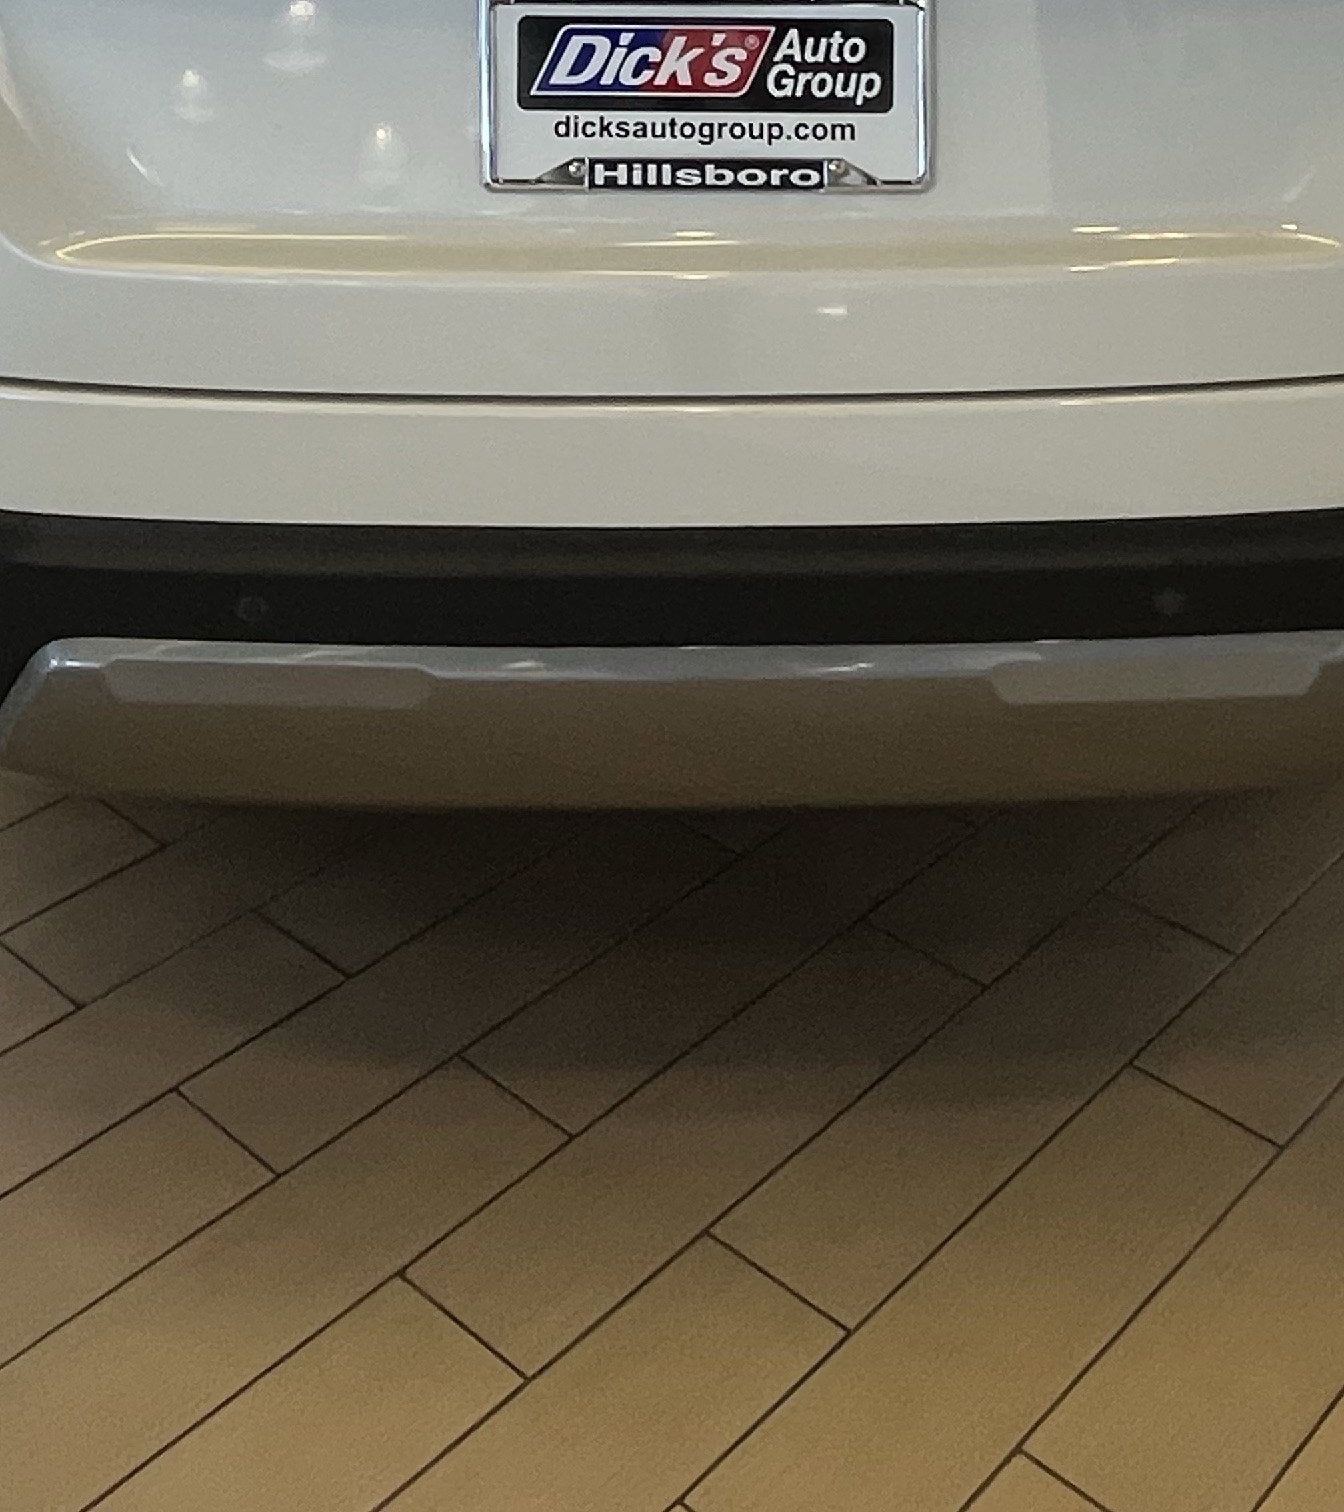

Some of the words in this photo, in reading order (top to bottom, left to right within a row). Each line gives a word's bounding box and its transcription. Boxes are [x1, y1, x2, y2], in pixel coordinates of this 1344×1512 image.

[548, 32, 749, 87] Dick's
[772, 28, 867, 64] Auto
[766, 63, 882, 106] Group
[554, 116, 856, 145] dicksautogroup.com
[592, 161, 822, 187] Hillsboro
